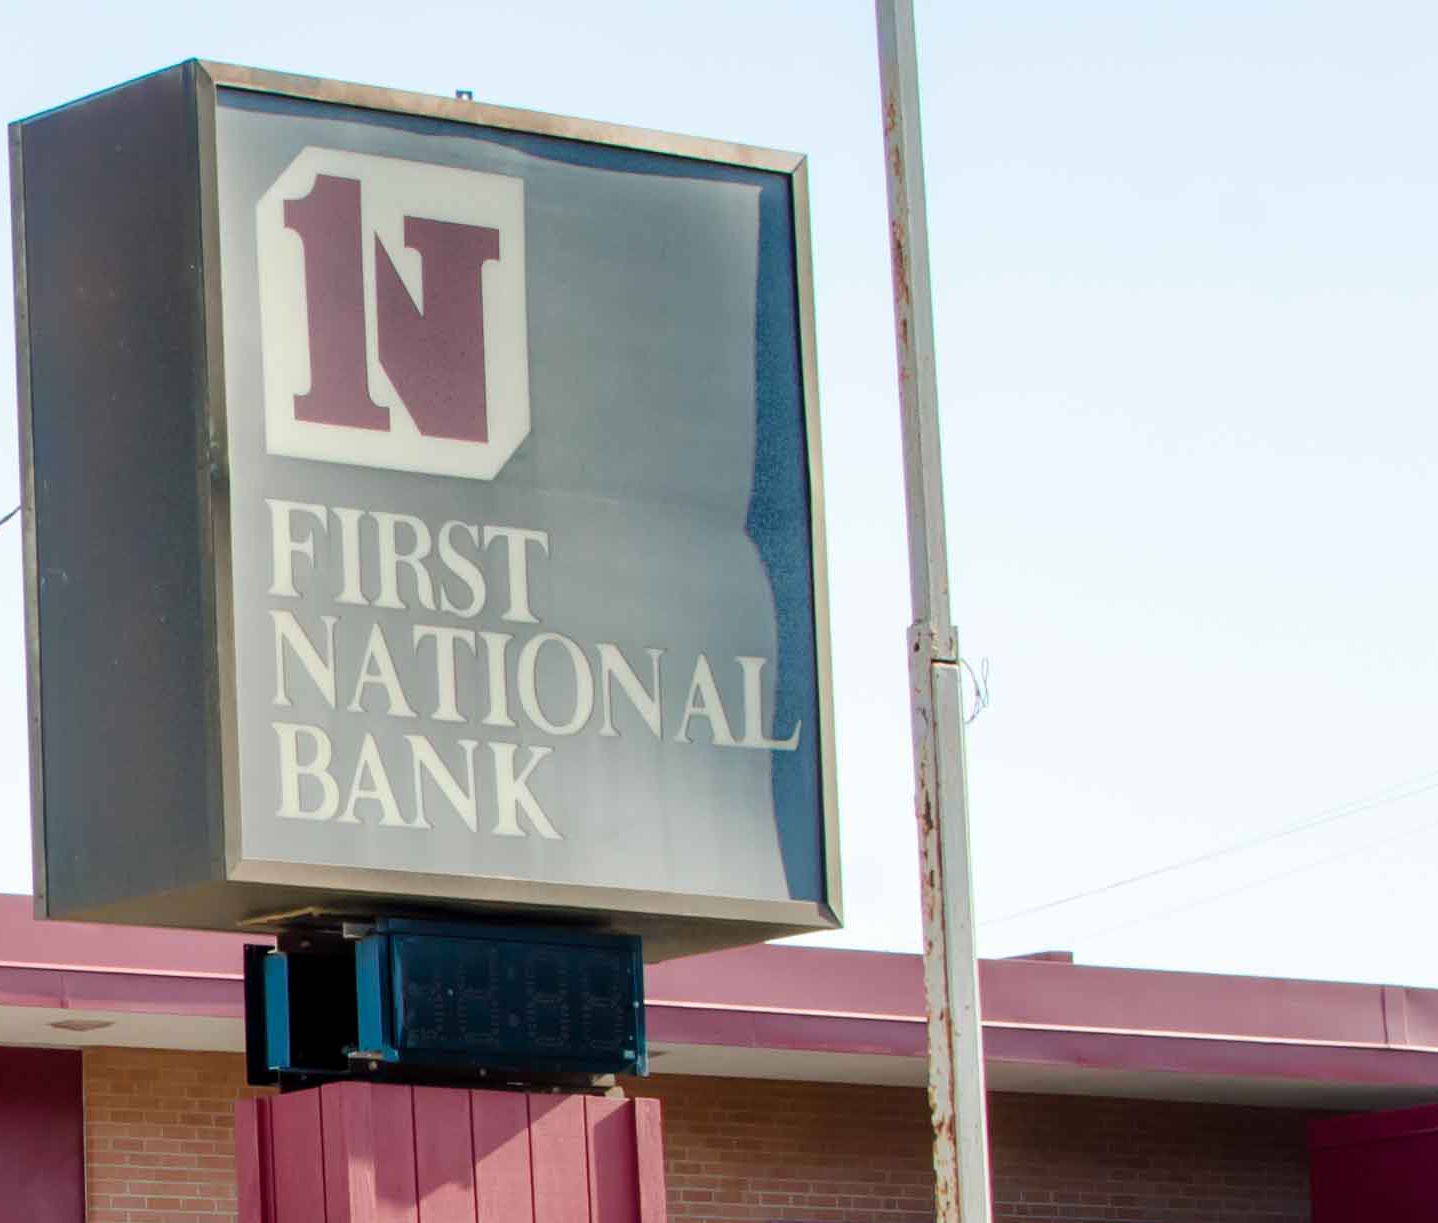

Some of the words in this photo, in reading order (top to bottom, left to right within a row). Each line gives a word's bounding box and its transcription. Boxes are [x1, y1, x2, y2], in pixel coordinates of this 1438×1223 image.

[265, 498, 551, 623] FIRST
[269, 609, 802, 751] NATIONAL
[272, 721, 563, 840] BANK
